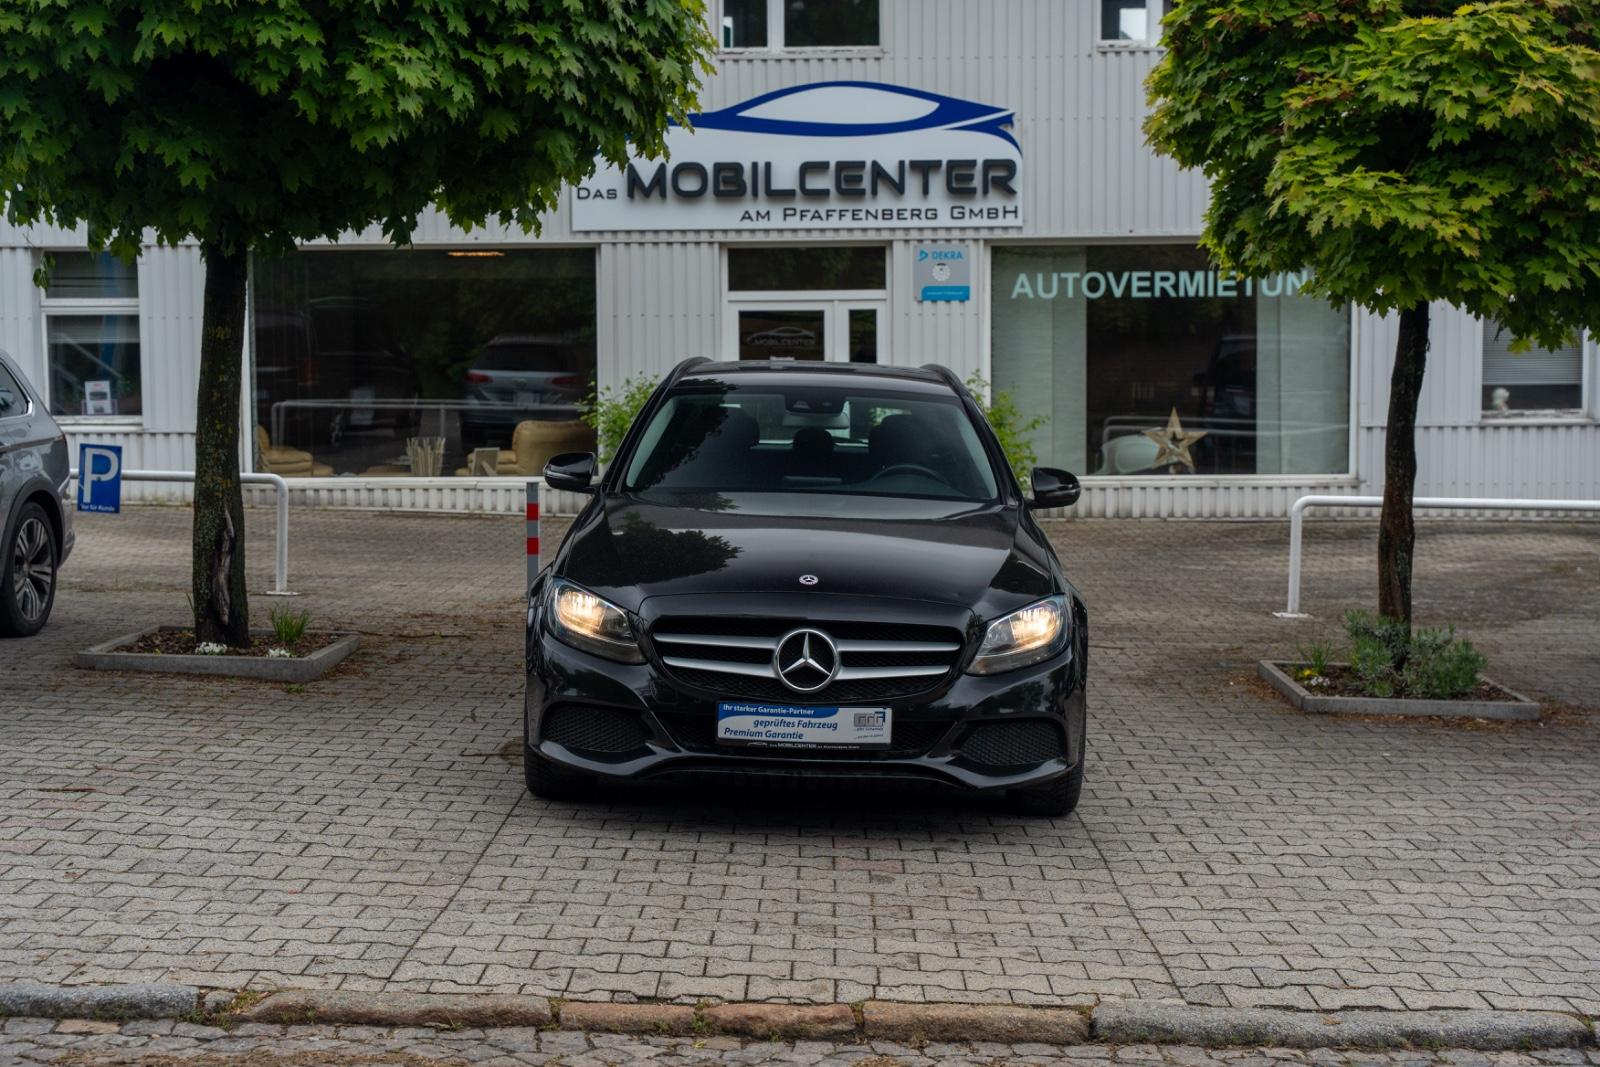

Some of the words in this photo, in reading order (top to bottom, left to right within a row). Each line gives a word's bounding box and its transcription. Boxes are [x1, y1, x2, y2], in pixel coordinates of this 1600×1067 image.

[626, 158, 1018, 199] MOBILCENTER
[740, 209, 771, 222] AM
[783, 206, 938, 222] PFAFFENBERG
[931, 250, 964, 260] DEKRA
[1011, 270, 1309, 299] AUTOVERMIETUN
[83, 447, 119, 503] P
[723, 703, 732, 711] Ihr
[734, 705, 757, 713] starker
[758, 706, 815, 715] Garantie-Partner
[753, 718, 795, 729] geprüftes
[797, 720, 838, 731] Fahrzeug
[724, 727, 763, 738] Premium
[765, 730, 804, 740] Garantie
